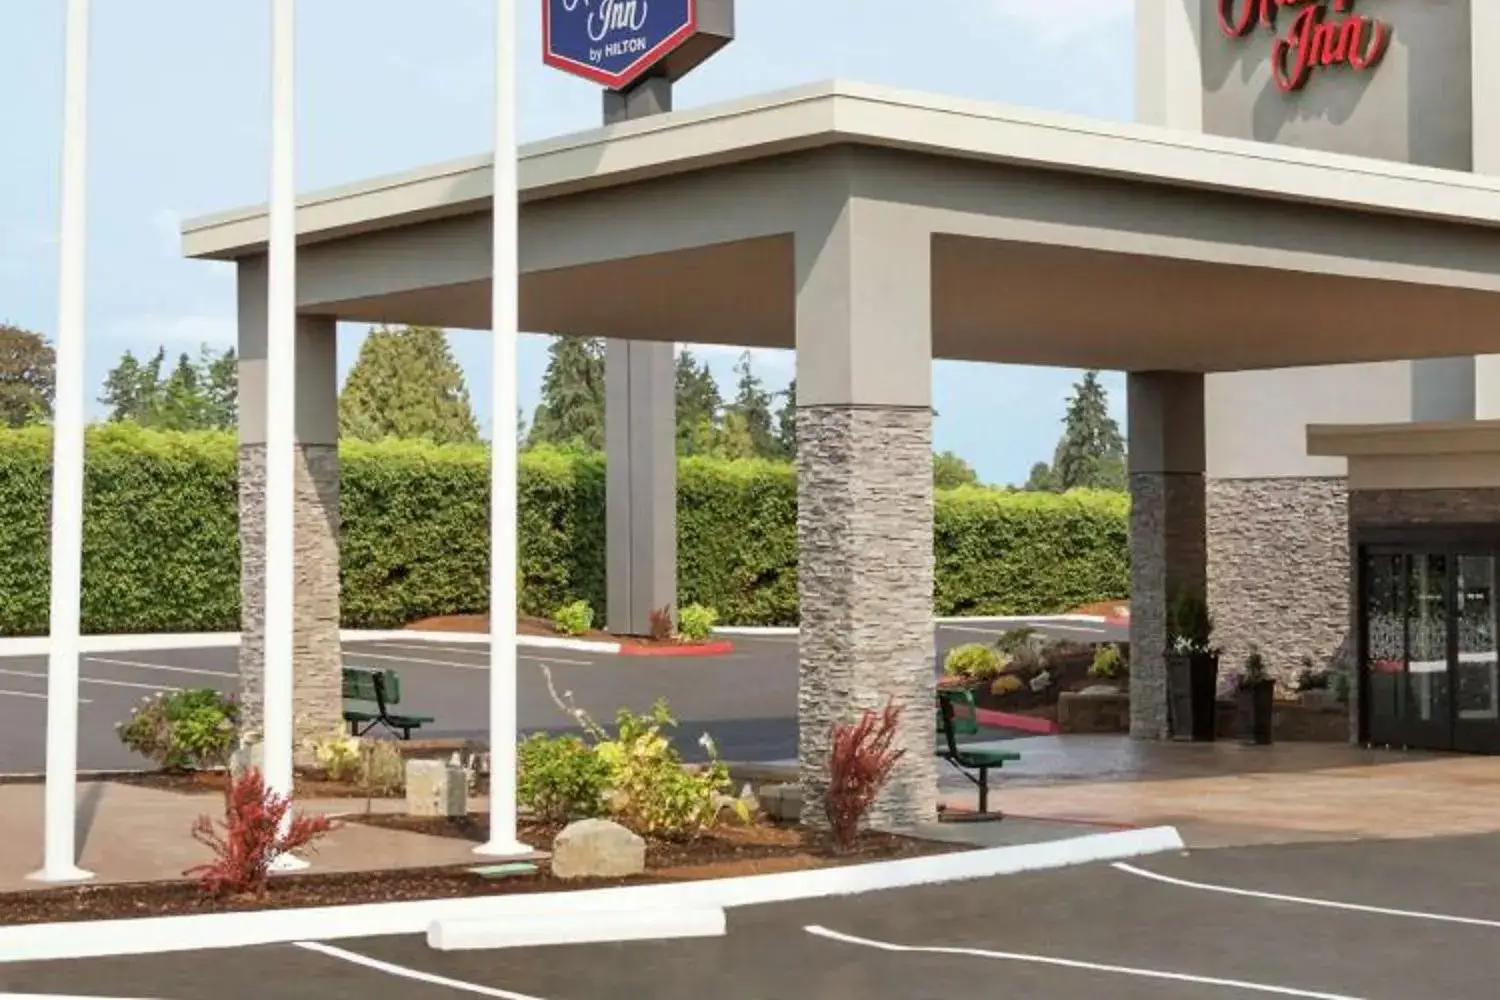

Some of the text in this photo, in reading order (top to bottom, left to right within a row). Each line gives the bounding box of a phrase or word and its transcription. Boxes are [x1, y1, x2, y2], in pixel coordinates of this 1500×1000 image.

[589, 36, 647, 64] by HILTON
[1271, 4, 1391, 93] Inn
